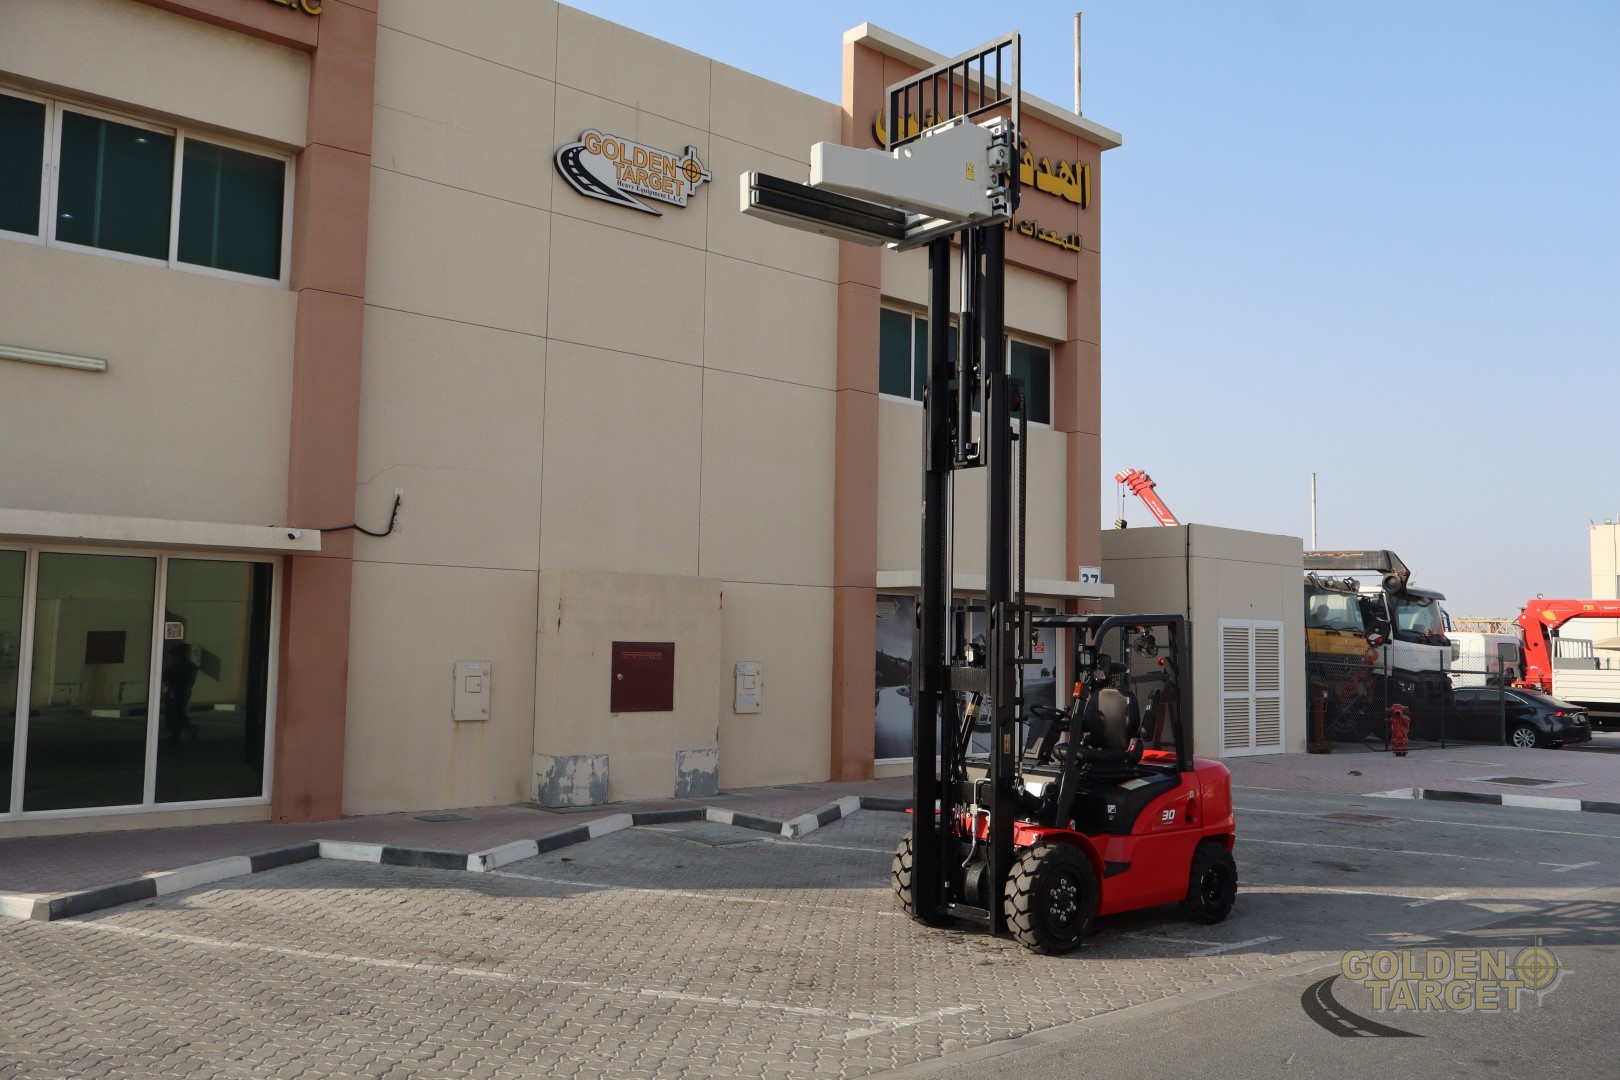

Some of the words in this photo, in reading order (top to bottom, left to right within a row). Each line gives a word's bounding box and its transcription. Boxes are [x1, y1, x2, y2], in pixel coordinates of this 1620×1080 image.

[585, 133, 676, 178] GOLDEN
[612, 161, 684, 197] TARGET
[616, 180, 635, 190] Heavy
[637, 184, 666, 198] Equipment
[1020, 219, 1082, 252] للمعدات
[1162, 809, 1176, 821] 30
